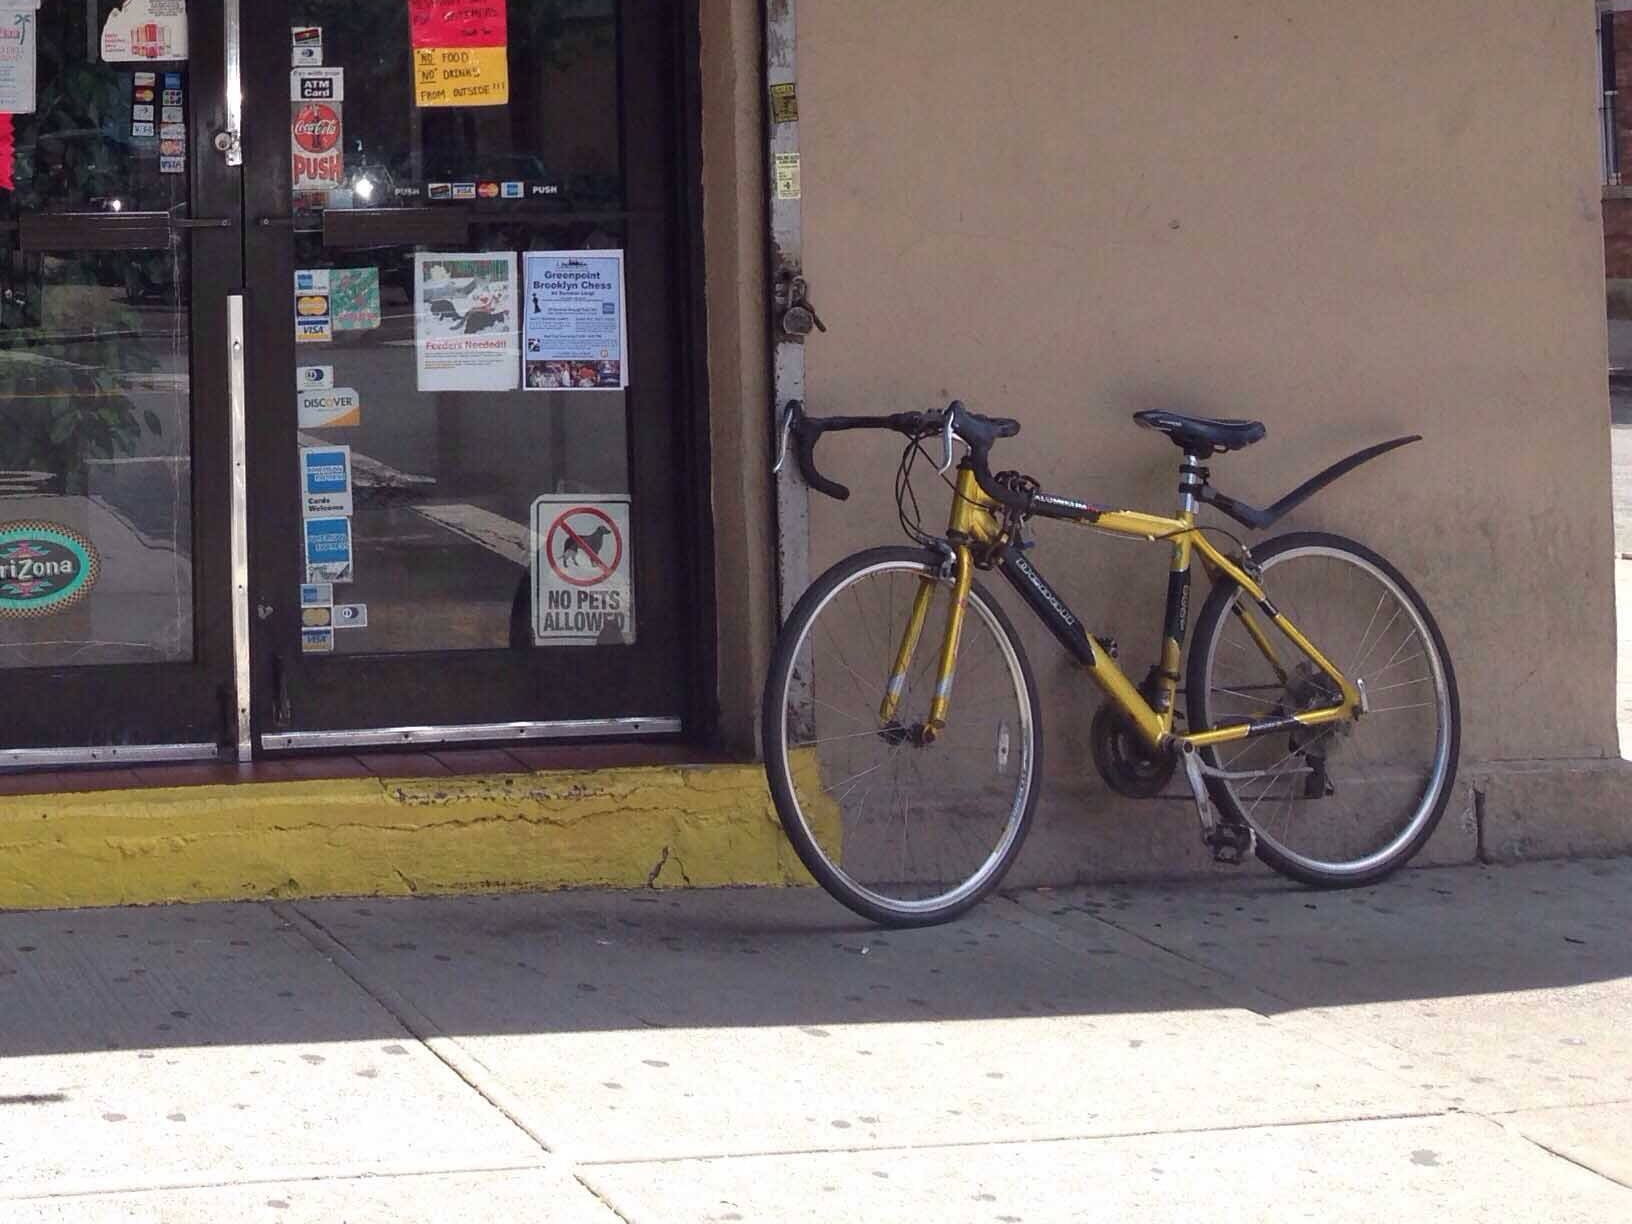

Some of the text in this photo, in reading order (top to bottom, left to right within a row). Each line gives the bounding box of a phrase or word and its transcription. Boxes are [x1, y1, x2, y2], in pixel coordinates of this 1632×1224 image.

[442, 52, 469, 63] FOOD
[304, 80, 330, 89] ATM
[304, 89, 330, 97] Card
[421, 89, 446, 101] FROM
[453, 85, 489, 97] OUTSIDE
[294, 153, 342, 185] PUSH
[532, 185, 557, 195] PUSH
[544, 270, 600, 280] Greenpoint
[533, 280, 612, 290] Brooklyn Chess
[303, 326, 324, 334] VISA
[304, 397, 352, 408] DISCOVER
[548, 590, 620, 610] NO PETS
